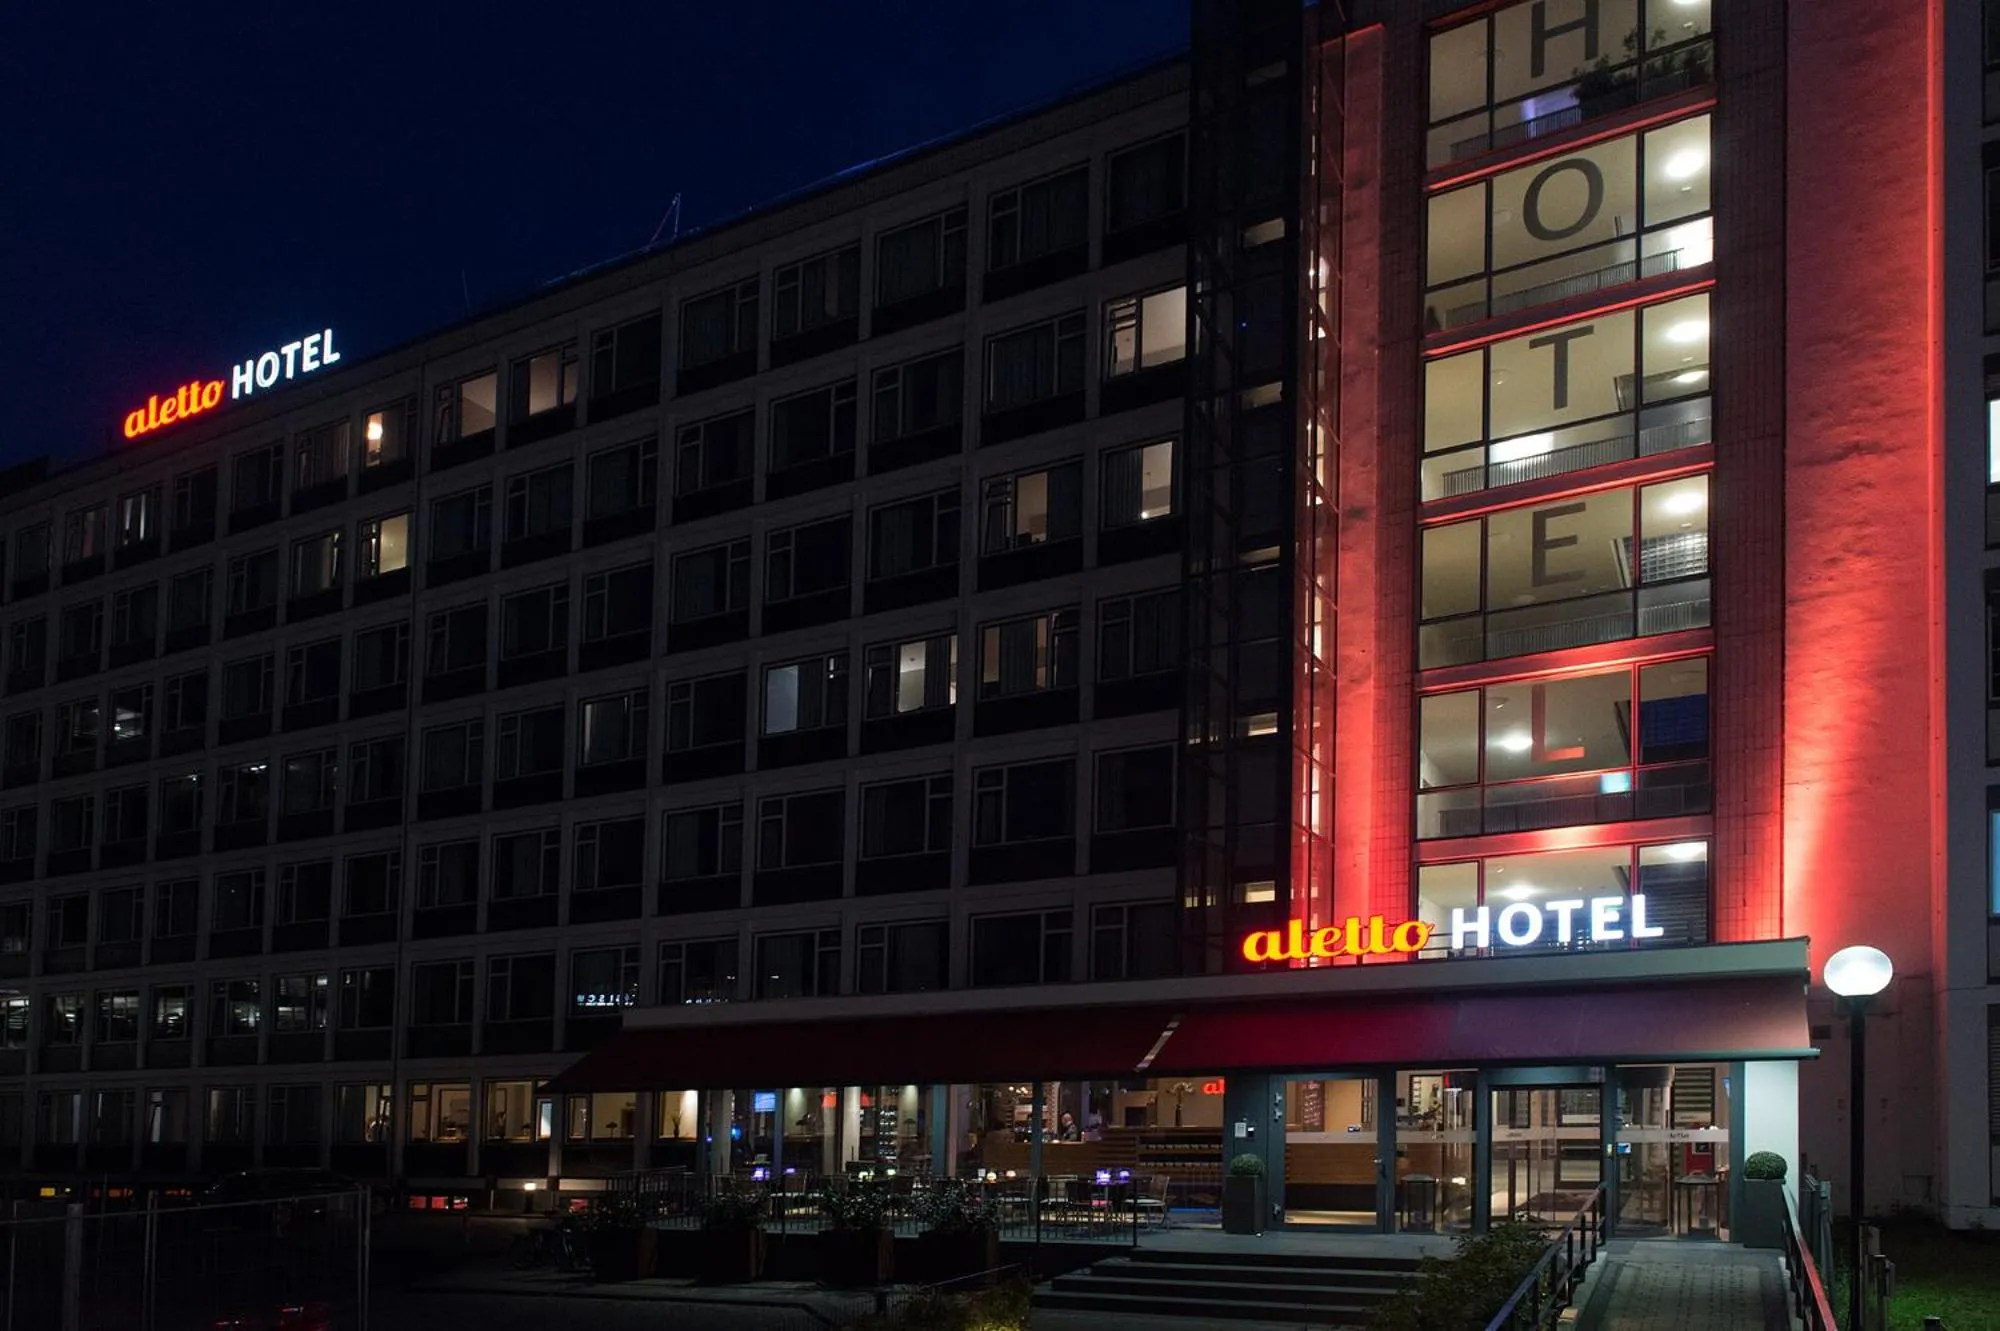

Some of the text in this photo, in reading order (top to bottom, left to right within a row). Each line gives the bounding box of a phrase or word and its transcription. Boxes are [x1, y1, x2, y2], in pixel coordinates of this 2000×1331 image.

[124, 328, 341, 439] aletto HOTEL
[1243, 894, 1664, 961] aletto HOTEL
